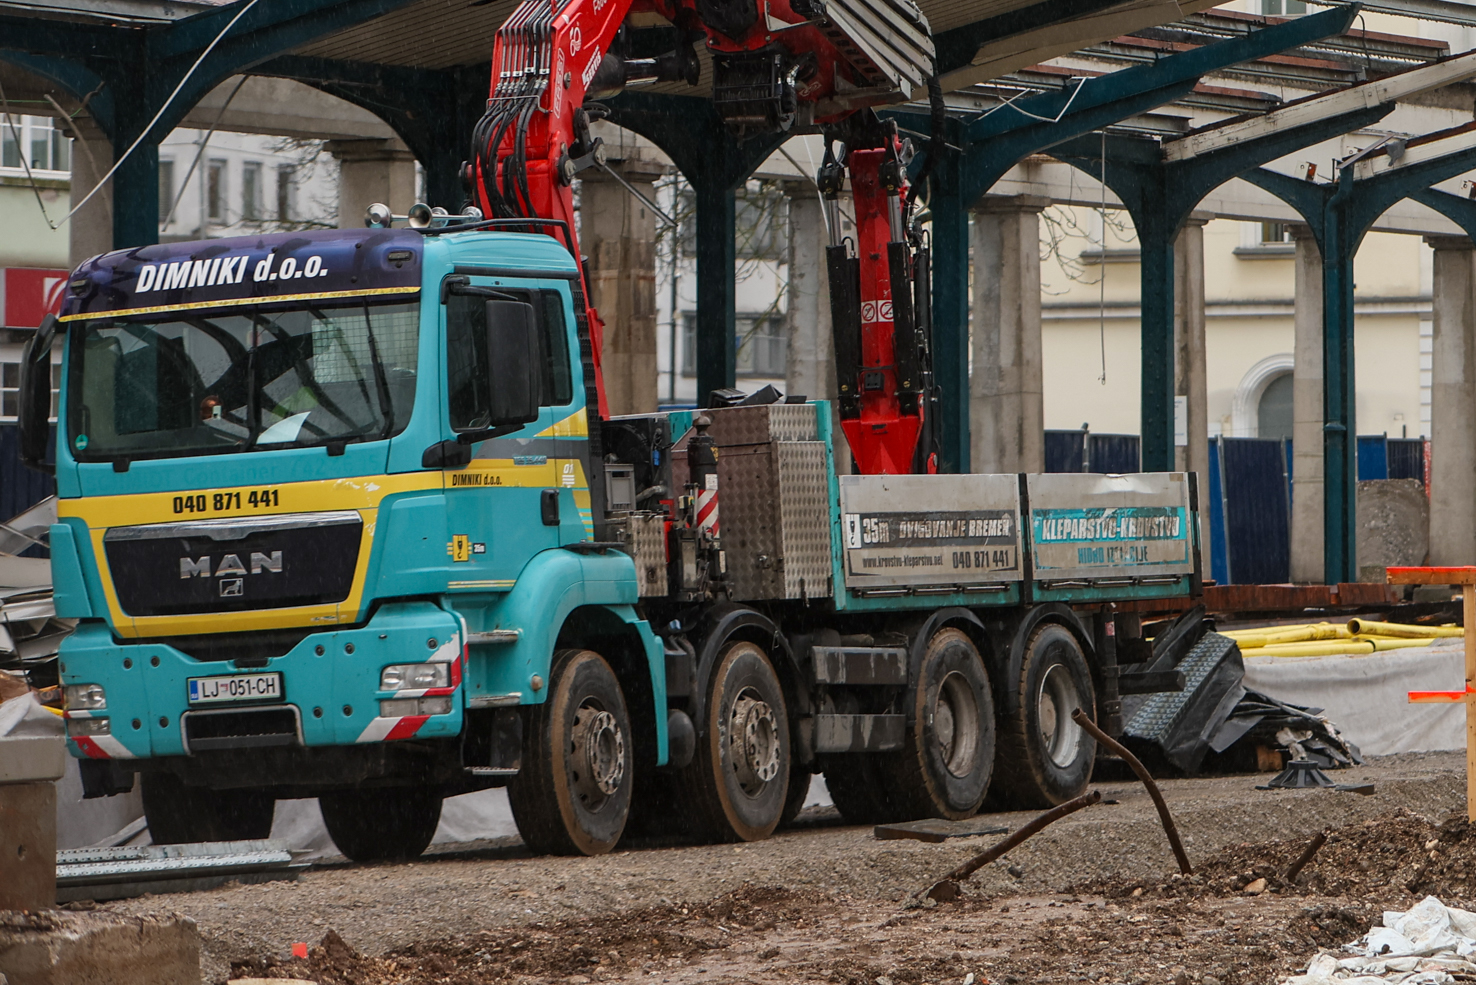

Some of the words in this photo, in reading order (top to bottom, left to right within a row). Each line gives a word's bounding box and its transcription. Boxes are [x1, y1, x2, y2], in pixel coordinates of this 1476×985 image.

[135, 255, 250, 294] DIMNIKI
[253, 253, 329, 283] d.o.o.
[452, 473, 482, 486] DIMNIKI
[484, 475, 502, 485] d.o.o.
[172, 495, 206, 514] 040
[213, 492, 241, 510] 871
[248, 489, 279, 508] 441
[863, 518, 889, 544] 35m
[899, 519, 966, 539] DVIGOVANJE
[180, 551, 282, 579] MAN
[952, 551, 971, 569] 040
[974, 550, 990, 568] 871
[993, 549, 1009, 567] 441
[202, 681, 219, 698] LJ
[229, 677, 276, 696] 051-CH
